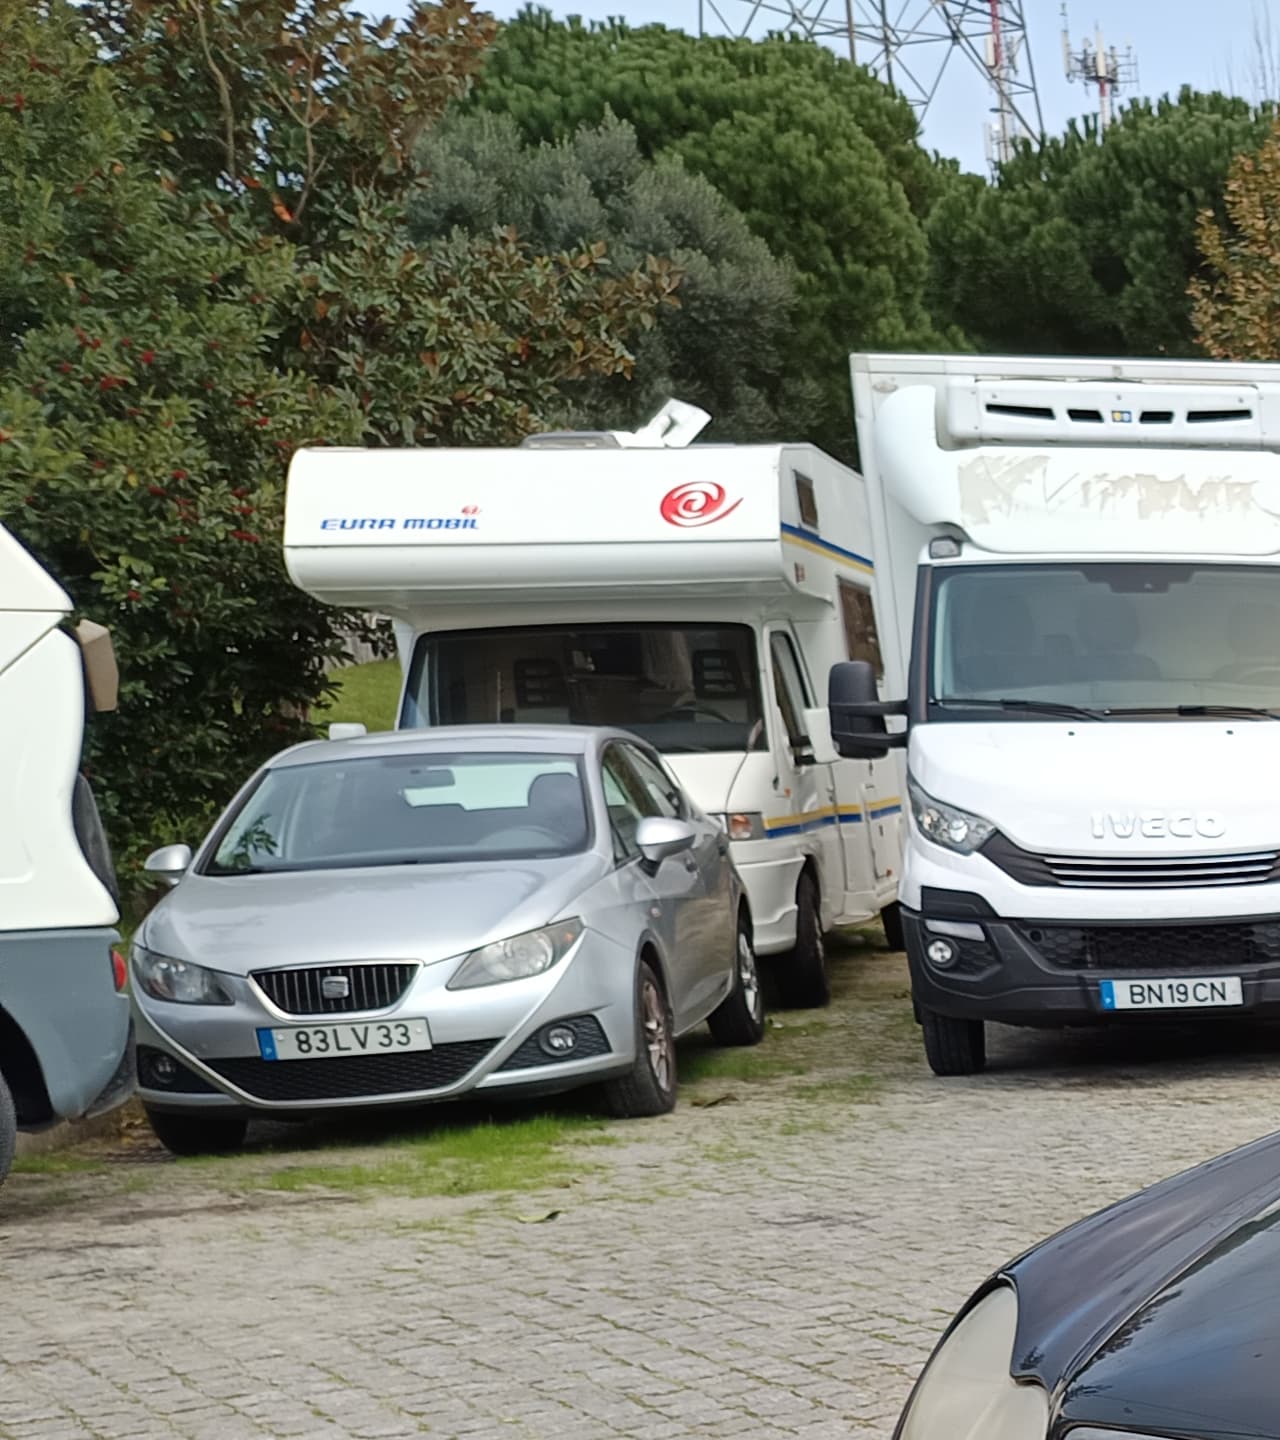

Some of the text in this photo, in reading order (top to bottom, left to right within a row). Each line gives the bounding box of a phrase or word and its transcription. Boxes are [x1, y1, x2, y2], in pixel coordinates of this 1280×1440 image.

[320, 518, 480, 531] EURA MOBIL
[1089, 811, 1226, 839] IVECO
[1129, 981, 1227, 1005] BN19CN
